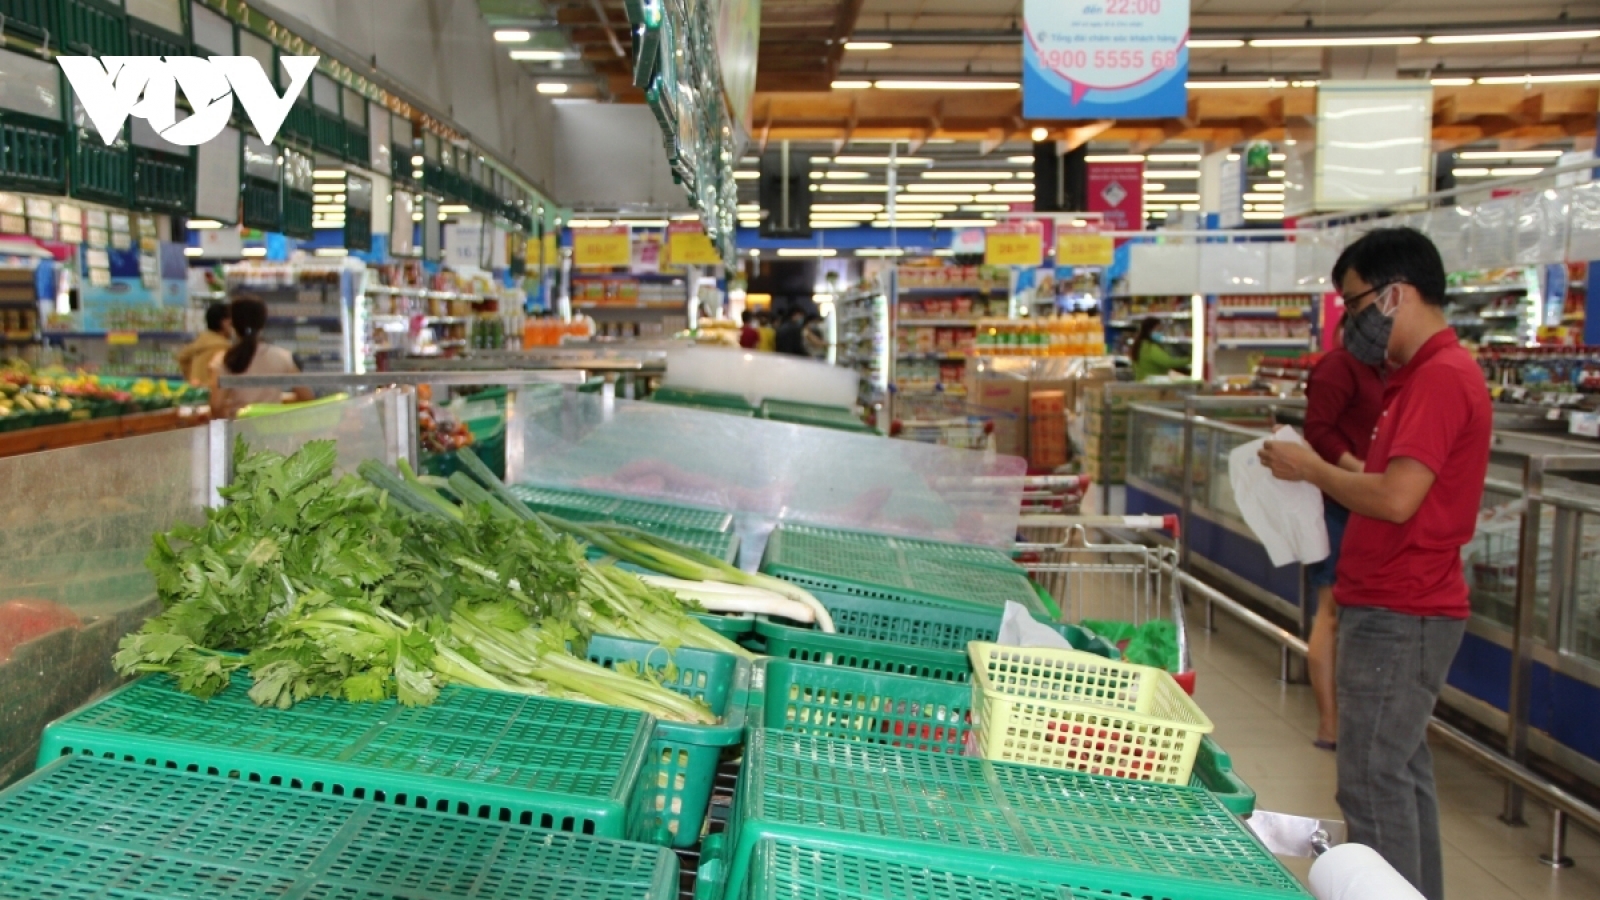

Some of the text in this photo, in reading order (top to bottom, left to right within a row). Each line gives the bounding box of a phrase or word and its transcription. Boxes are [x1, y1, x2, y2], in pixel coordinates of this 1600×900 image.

[1106, 0, 1161, 15] 22:00
[1039, 50, 1178, 69] 1900 5555 68
